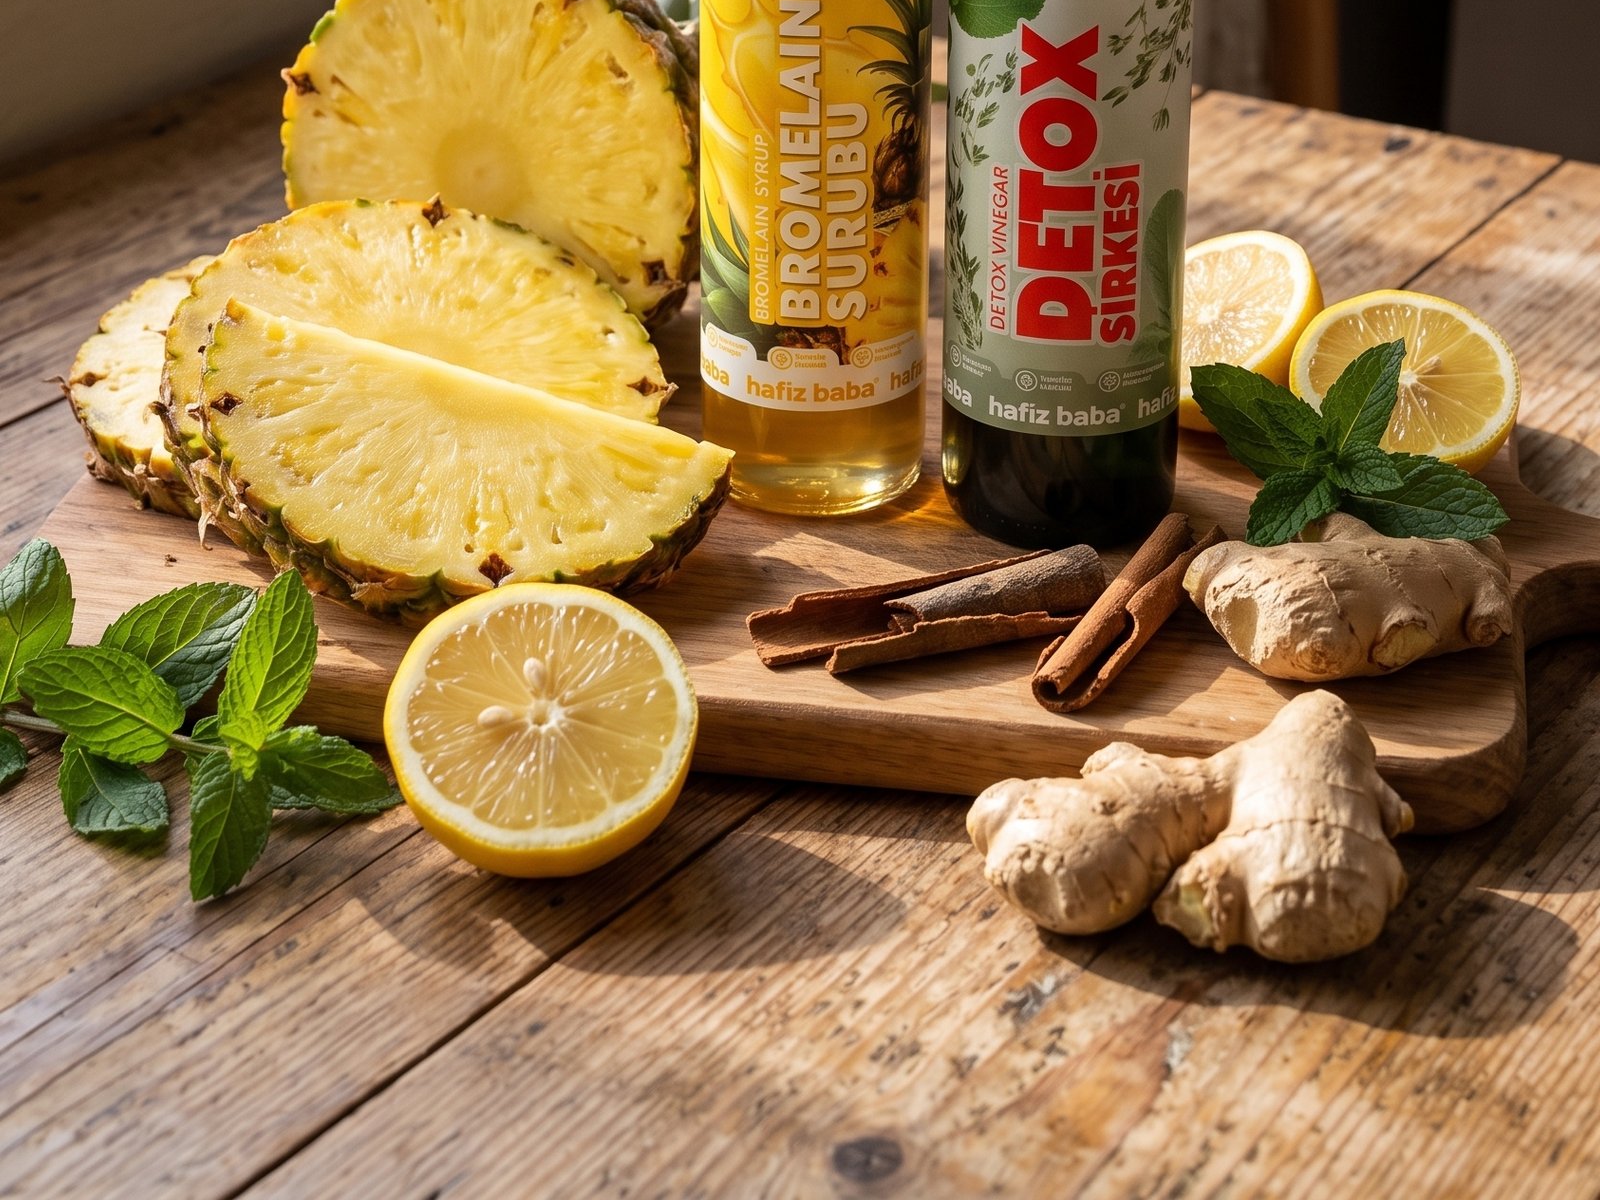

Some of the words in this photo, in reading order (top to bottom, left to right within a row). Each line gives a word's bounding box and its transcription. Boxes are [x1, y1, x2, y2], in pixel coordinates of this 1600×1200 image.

[755, 134, 769, 197] SYRUP
[1016, 22, 1099, 341] DETOX
[992, 165, 1009, 255] VINEGAR
[755, 205, 769, 320] BROMELAIN
[990, 260, 1007, 330] DETOX
[813, 381, 875, 403] baba
[1056, 405, 1121, 427] baba
